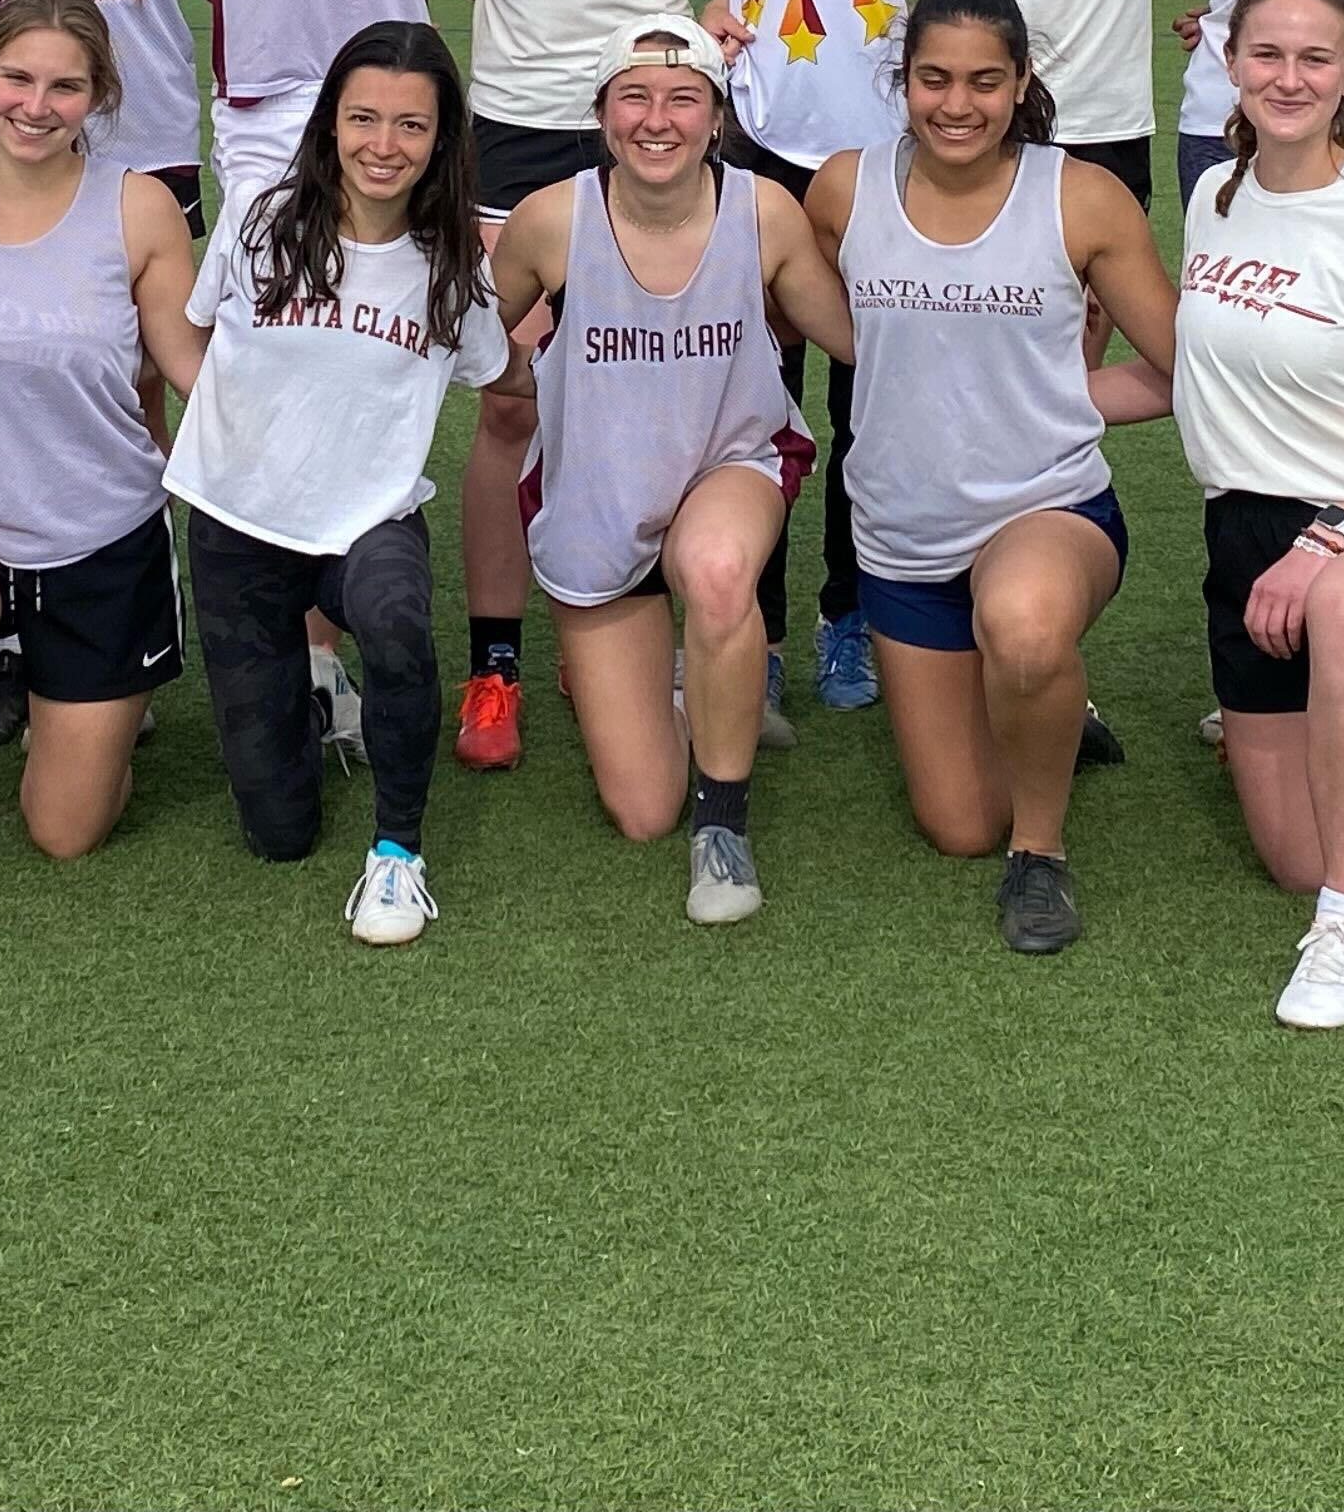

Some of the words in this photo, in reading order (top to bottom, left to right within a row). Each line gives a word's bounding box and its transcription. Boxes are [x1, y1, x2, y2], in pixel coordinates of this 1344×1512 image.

[855, 279, 932, 299] SANTA
[942, 283, 1044, 305] CLARA
[900, 299, 982, 313] ULTIMATE
[986, 303, 1043, 317] WOMEN
[586, 326, 664, 363] SANTA
